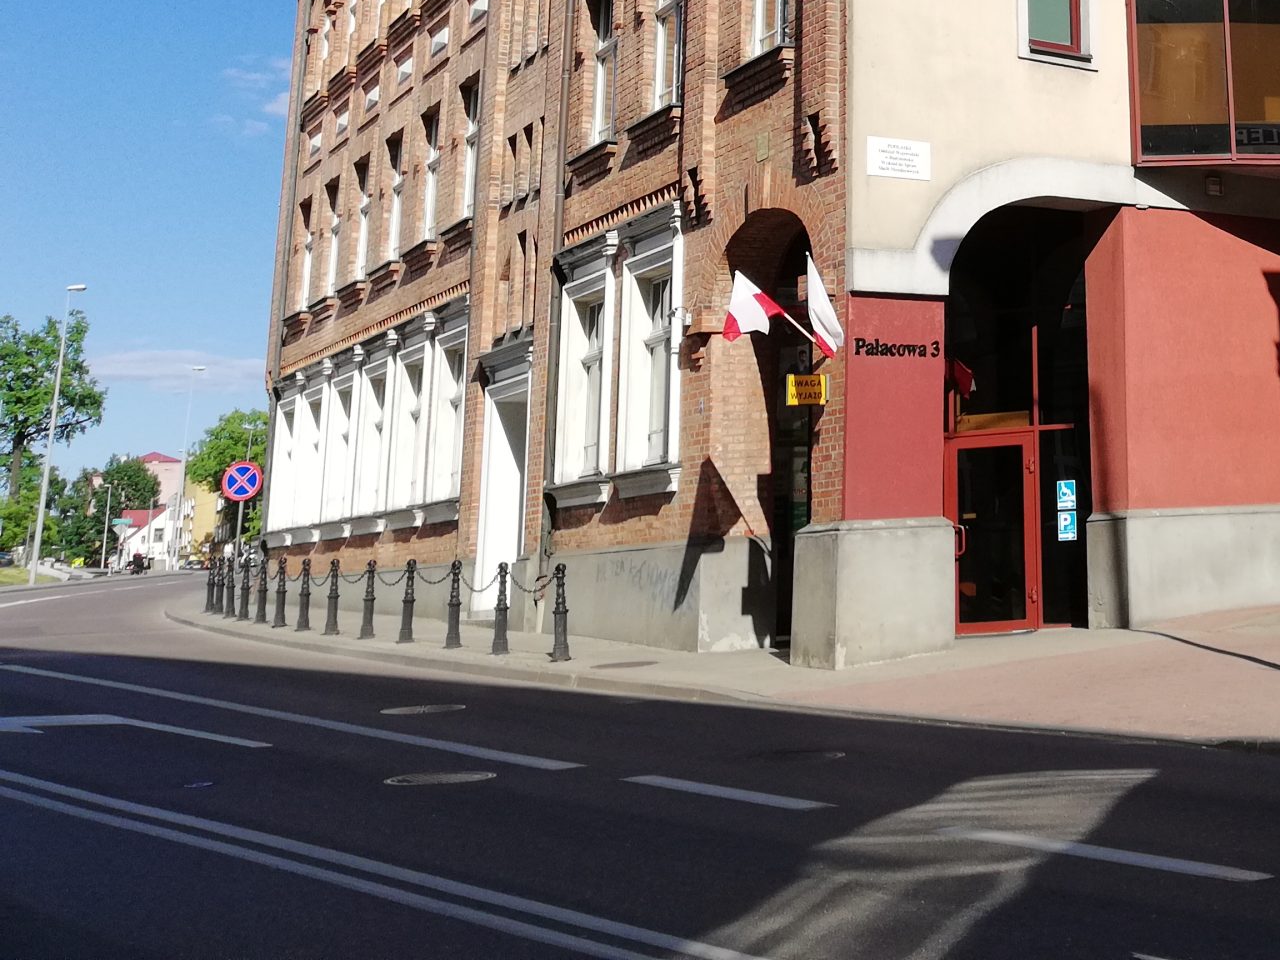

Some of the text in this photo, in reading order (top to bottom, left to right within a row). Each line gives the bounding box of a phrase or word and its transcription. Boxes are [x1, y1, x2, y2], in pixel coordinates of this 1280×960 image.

[854, 338, 941, 358] Pałacowa 3
[791, 380, 822, 388] UWAGA
[790, 392, 822, 400] WYJAZD
